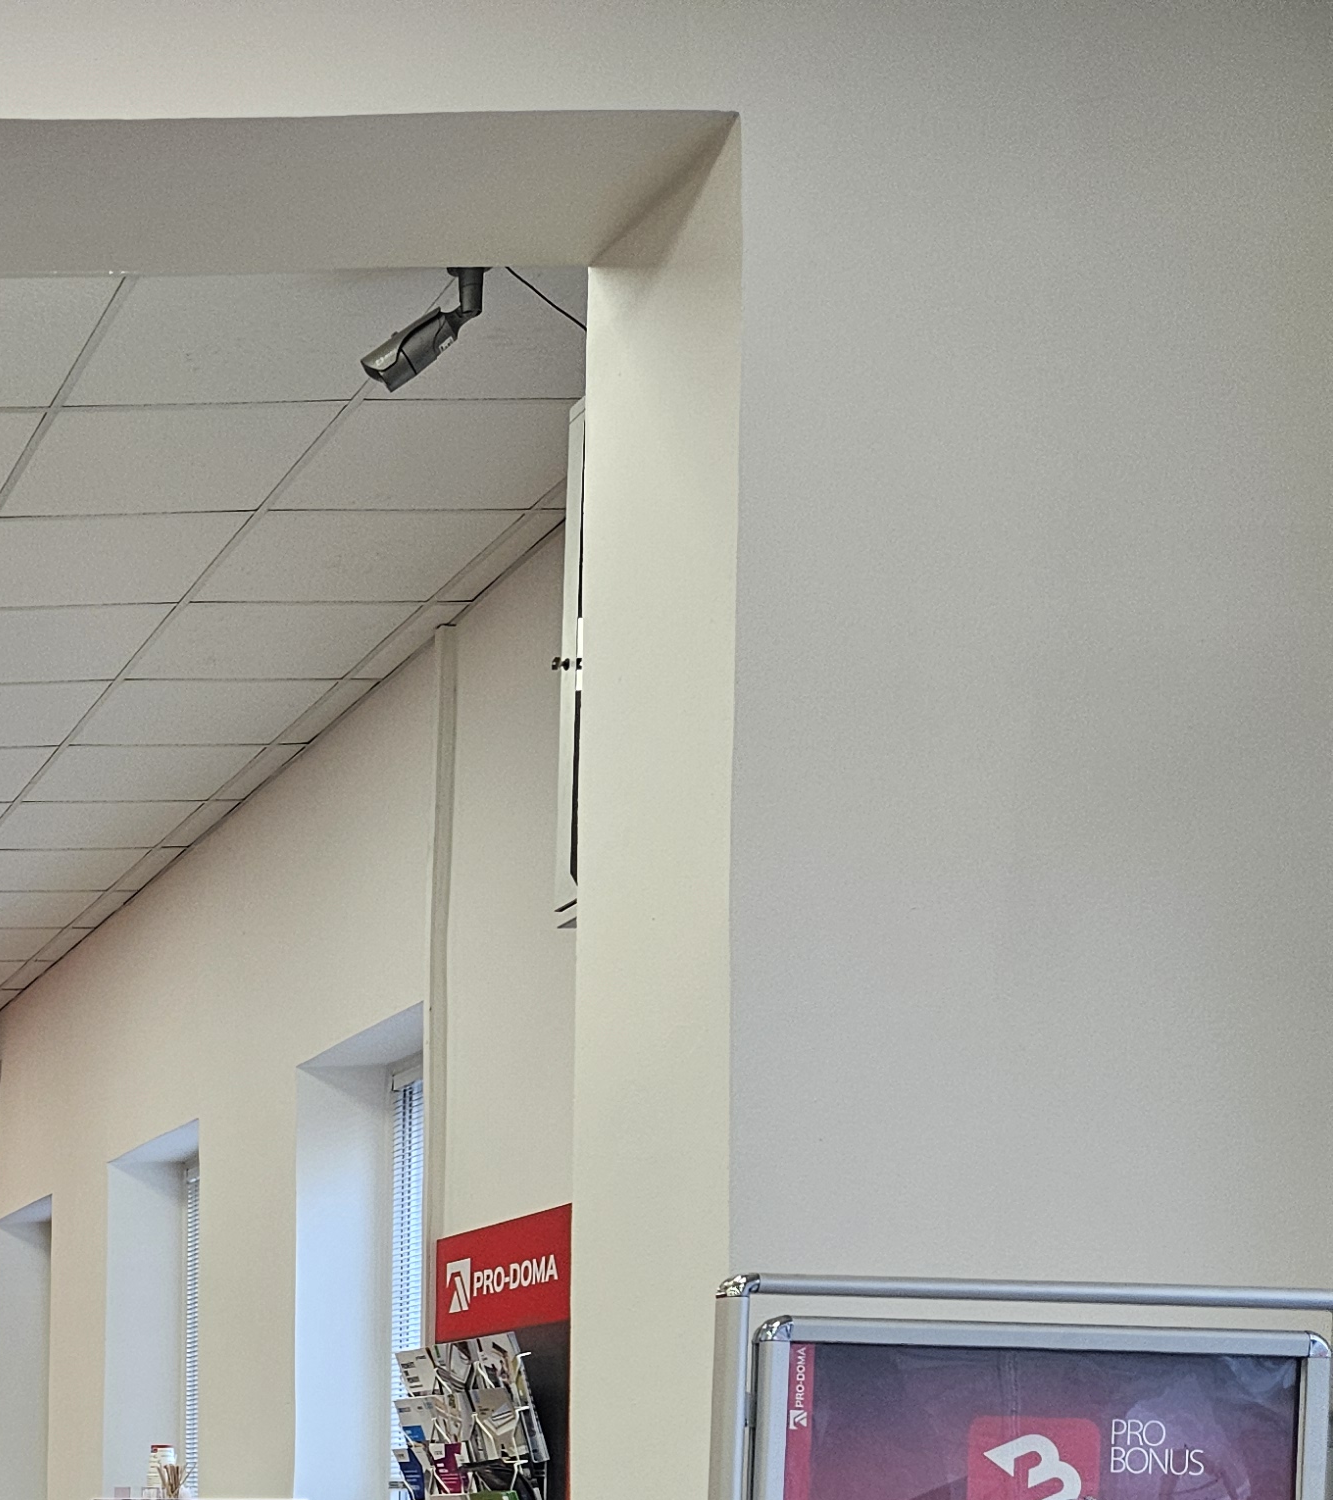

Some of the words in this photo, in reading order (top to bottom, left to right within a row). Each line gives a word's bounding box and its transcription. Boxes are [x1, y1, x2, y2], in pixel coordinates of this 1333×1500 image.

[473, 1254, 559, 1298] PRO-DOMA
[795, 1346, 807, 1408] PRO-DOMA
[1110, 1418, 1166, 1448] PRO
[1109, 1447, 1206, 1477] BONUS
